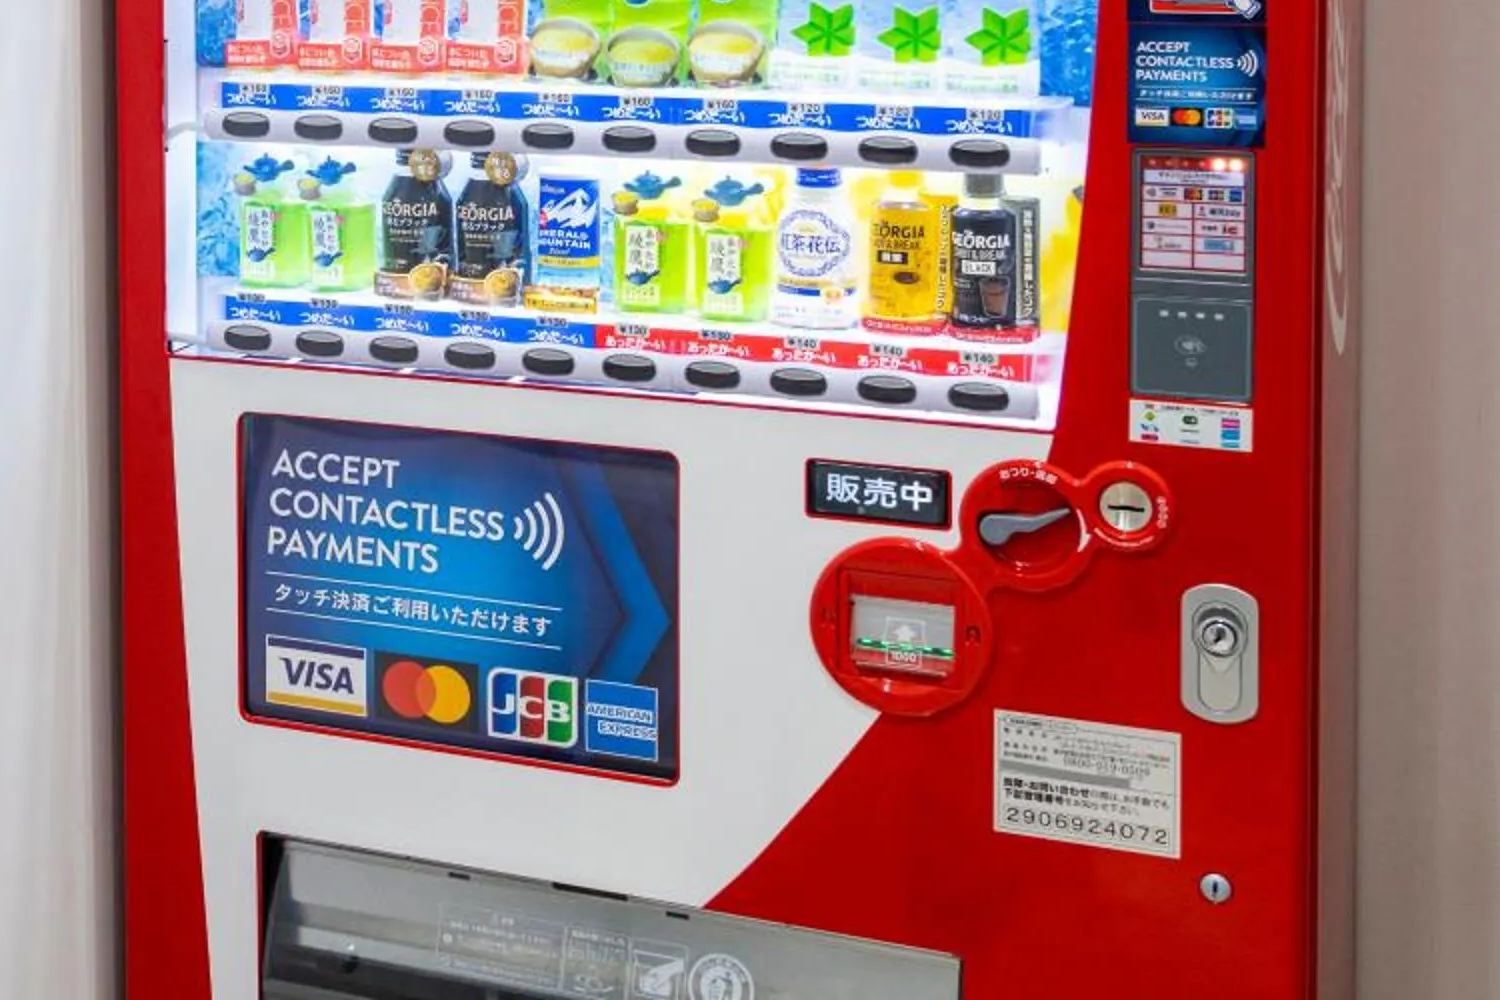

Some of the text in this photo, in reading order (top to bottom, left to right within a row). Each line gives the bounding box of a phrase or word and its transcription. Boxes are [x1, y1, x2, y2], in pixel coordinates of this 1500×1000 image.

[1136, 41, 1191, 53] ACCEPT
[1135, 55, 1234, 69] CONTACTLESS
[1135, 69, 1208, 82] PAYMENTS
[540, 229, 588, 241] MERALD
[873, 221, 925, 240] EORGIA
[539, 238, 591, 250] OUNTAIN
[964, 262, 994, 273] BLACK
[272, 448, 399, 489] ACCEPT
[826, 473, 933, 511] 販売中
[269, 487, 504, 542] CONTACTLESS
[267, 526, 439, 574] PAYMENTS
[275, 583, 551, 637] タッチ決済ご利用いただけます
[279, 656, 570, 723] VISA JCB
[587, 702, 651, 722] AMERICAN
[1007, 807, 1167, 845] 2906924072
